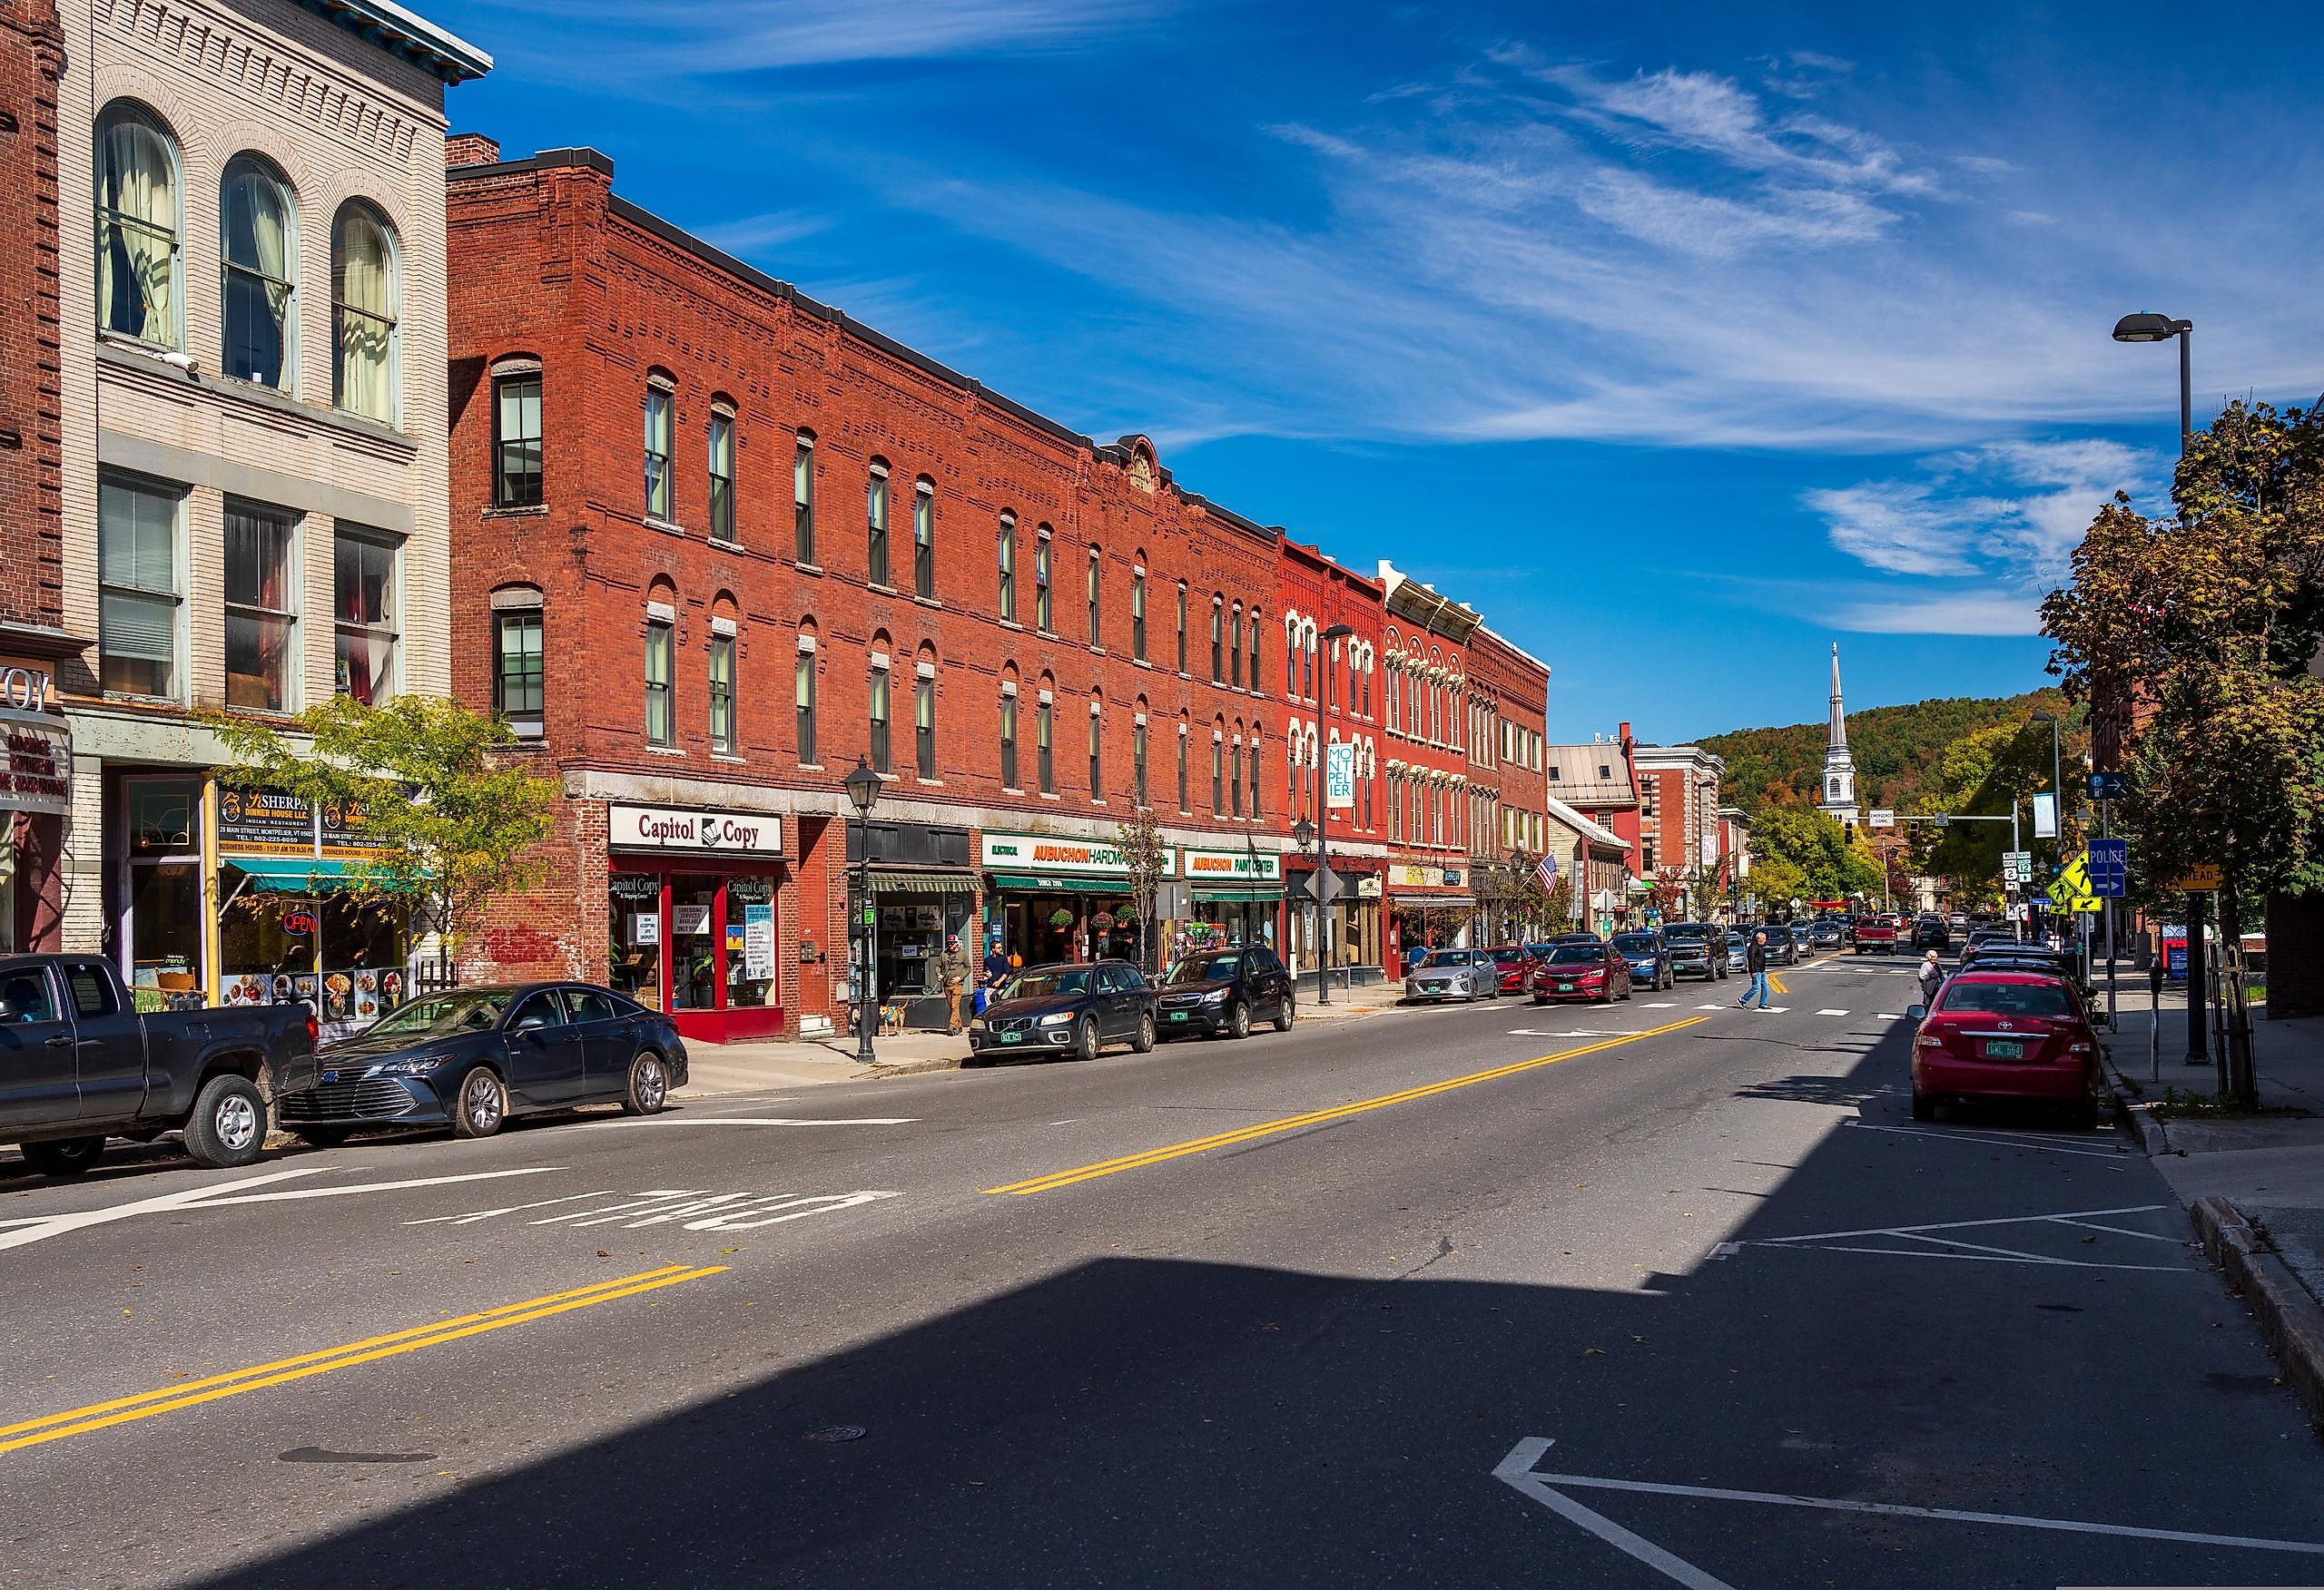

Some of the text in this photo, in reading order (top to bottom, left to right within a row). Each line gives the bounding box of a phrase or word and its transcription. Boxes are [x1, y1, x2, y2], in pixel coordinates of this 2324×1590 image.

[245, 808, 310, 820] DINNER HOUSE LLC.
[638, 814, 759, 849] Capitol Copy
[1033, 845, 1089, 864] AUBUCHON
[2090, 849, 2124, 864] POLICE
[1192, 857, 1274, 873] AUBUCHON PAINT CENTER
[2020, 864, 2029, 872] 12
[2008, 869, 2014, 878] 2
[637, 878, 660, 895] Copy
[726, 879, 772, 897] Capitol Copy
[283, 914, 315, 933] OPEN
[165, 957, 186, 966] menufy
[141, 1004, 162, 1013] LIVE
[2006, 1045, 2020, 1054] 664
